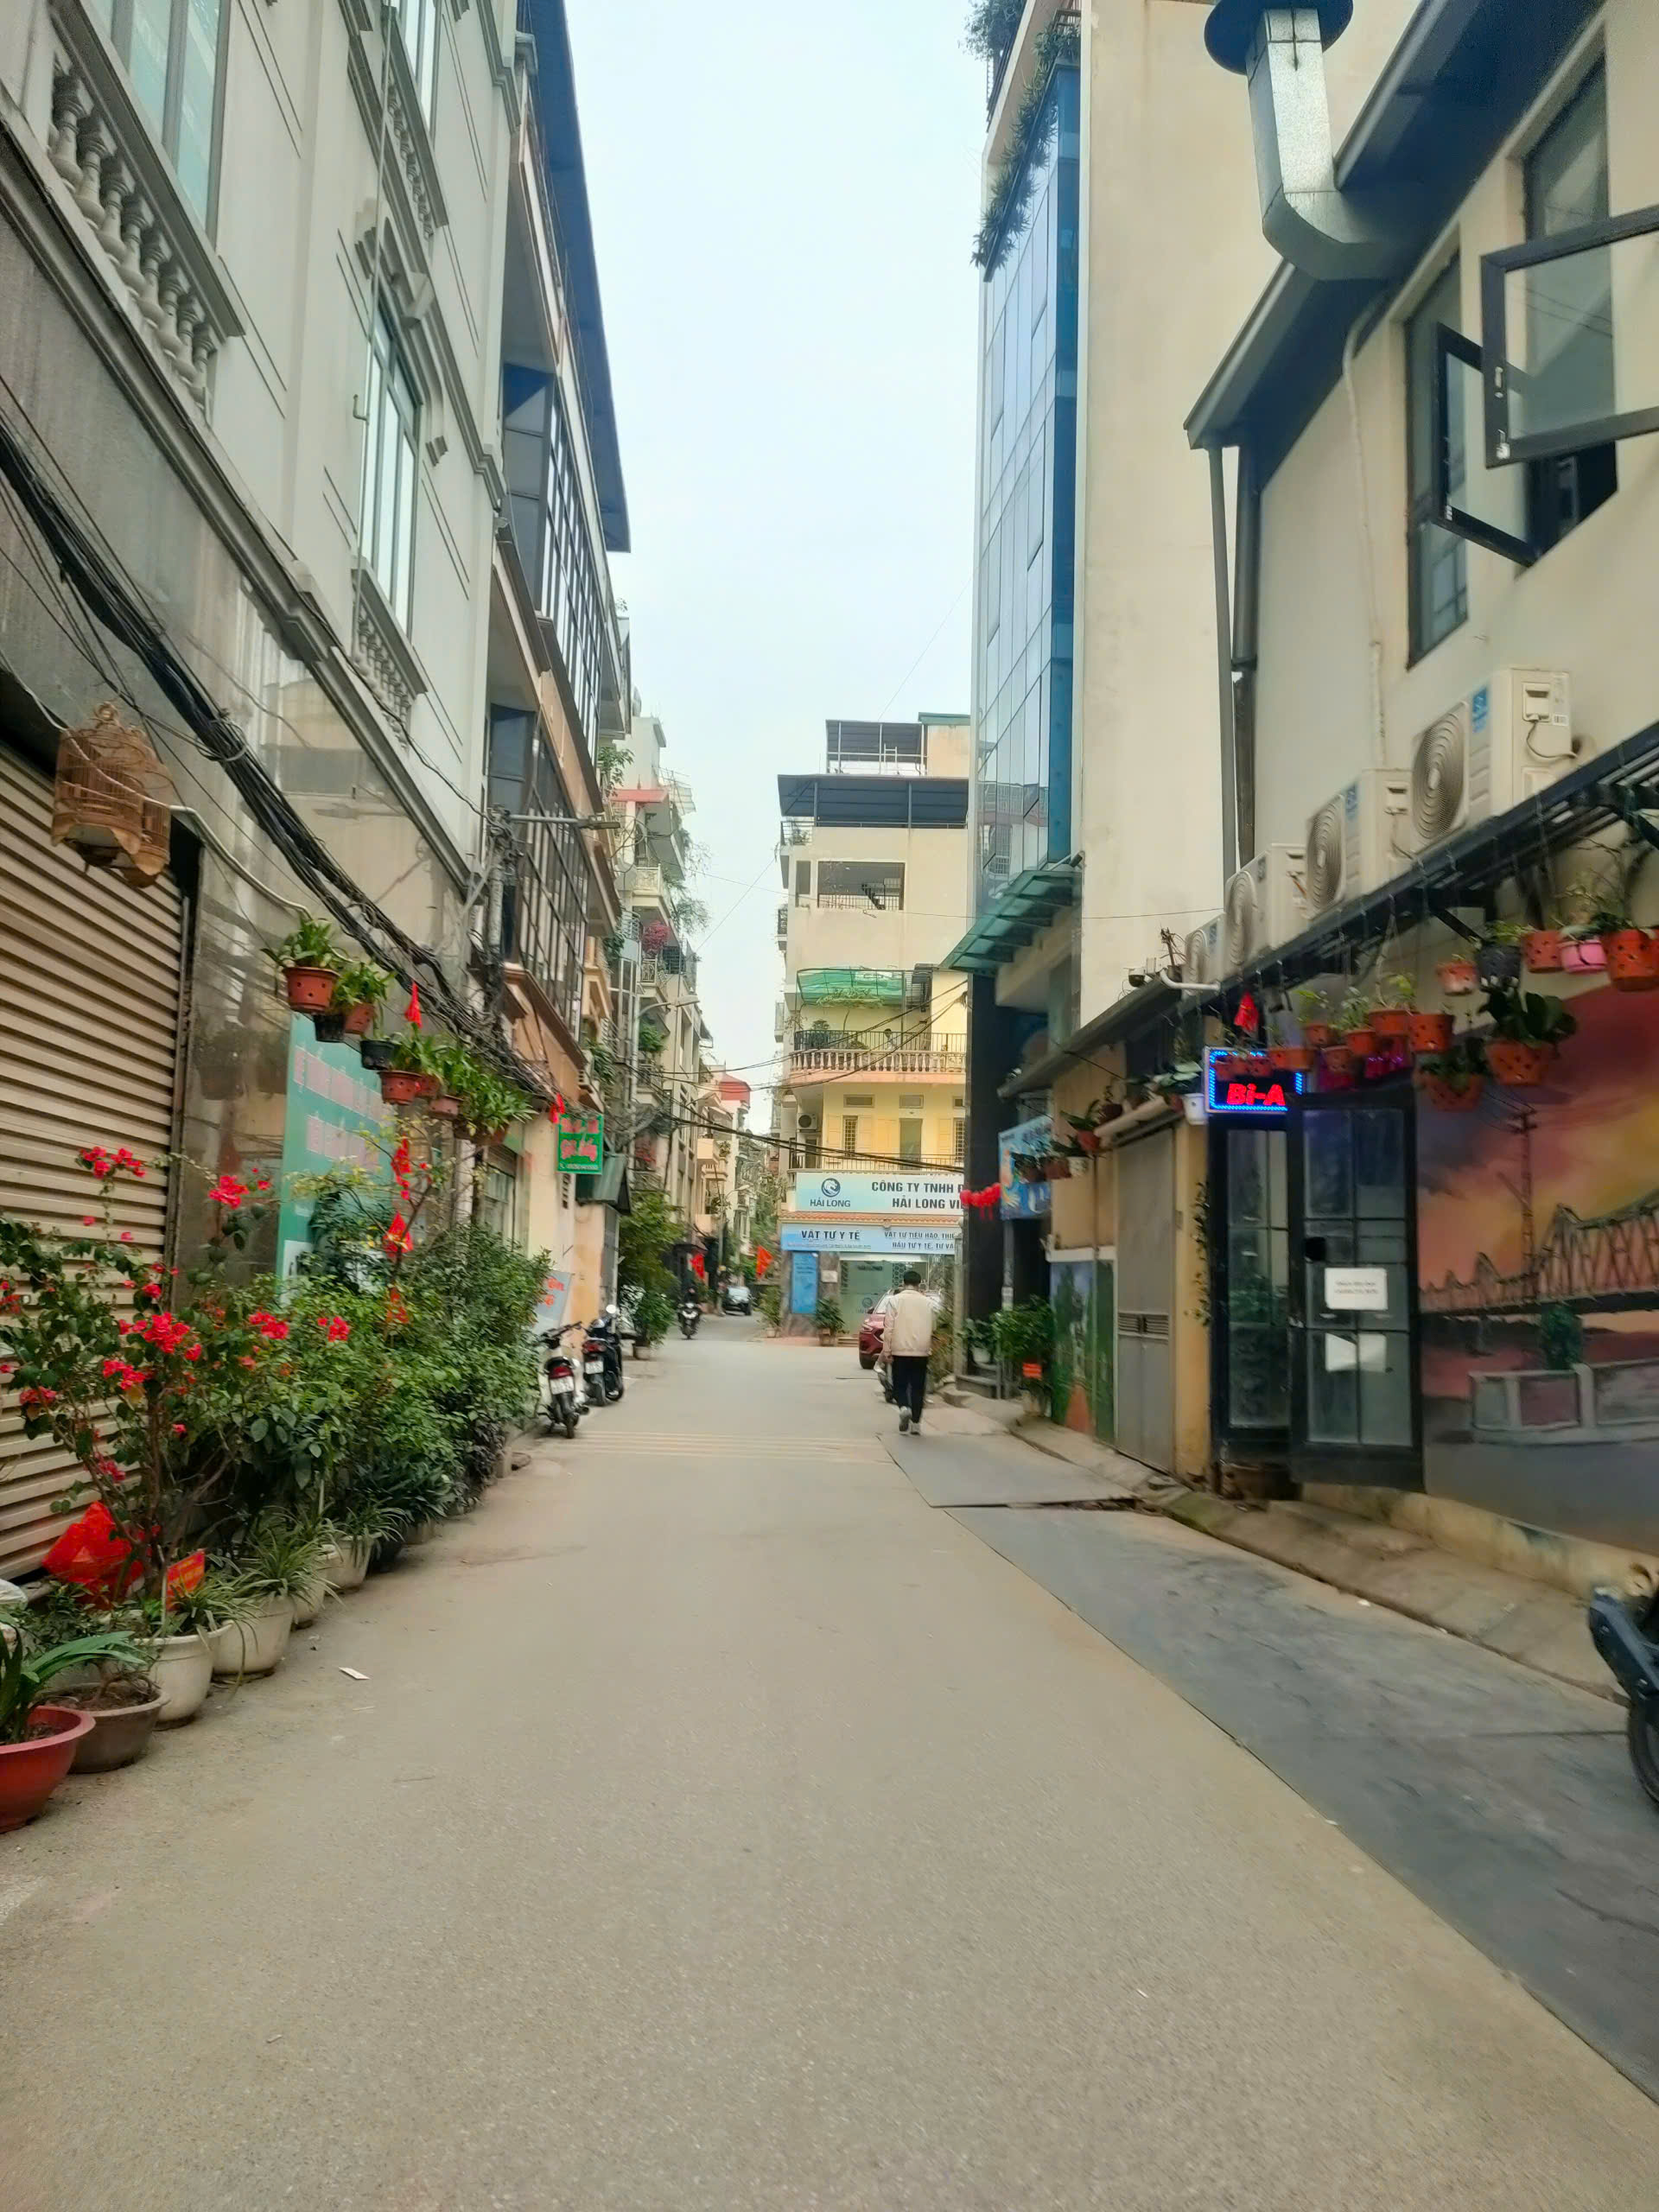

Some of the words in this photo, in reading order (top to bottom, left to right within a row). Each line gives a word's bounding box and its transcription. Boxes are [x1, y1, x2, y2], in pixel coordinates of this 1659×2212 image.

[1226, 1083, 1286, 1106] Bi-A
[872, 1179, 903, 1192] CÔNG
[906, 1182, 920, 1192] TY
[924, 1183, 954, 1193] TNHH
[810, 1197, 824, 1207] HẢI
[826, 1199, 851, 1208] LONG
[892, 1194, 912, 1208] HẢI
[915, 1198, 945, 1210] LONG
[801, 1229, 821, 1242] VẬT
[823, 1230, 837, 1240] TƯ
[839, 1230, 846, 1240] Y
